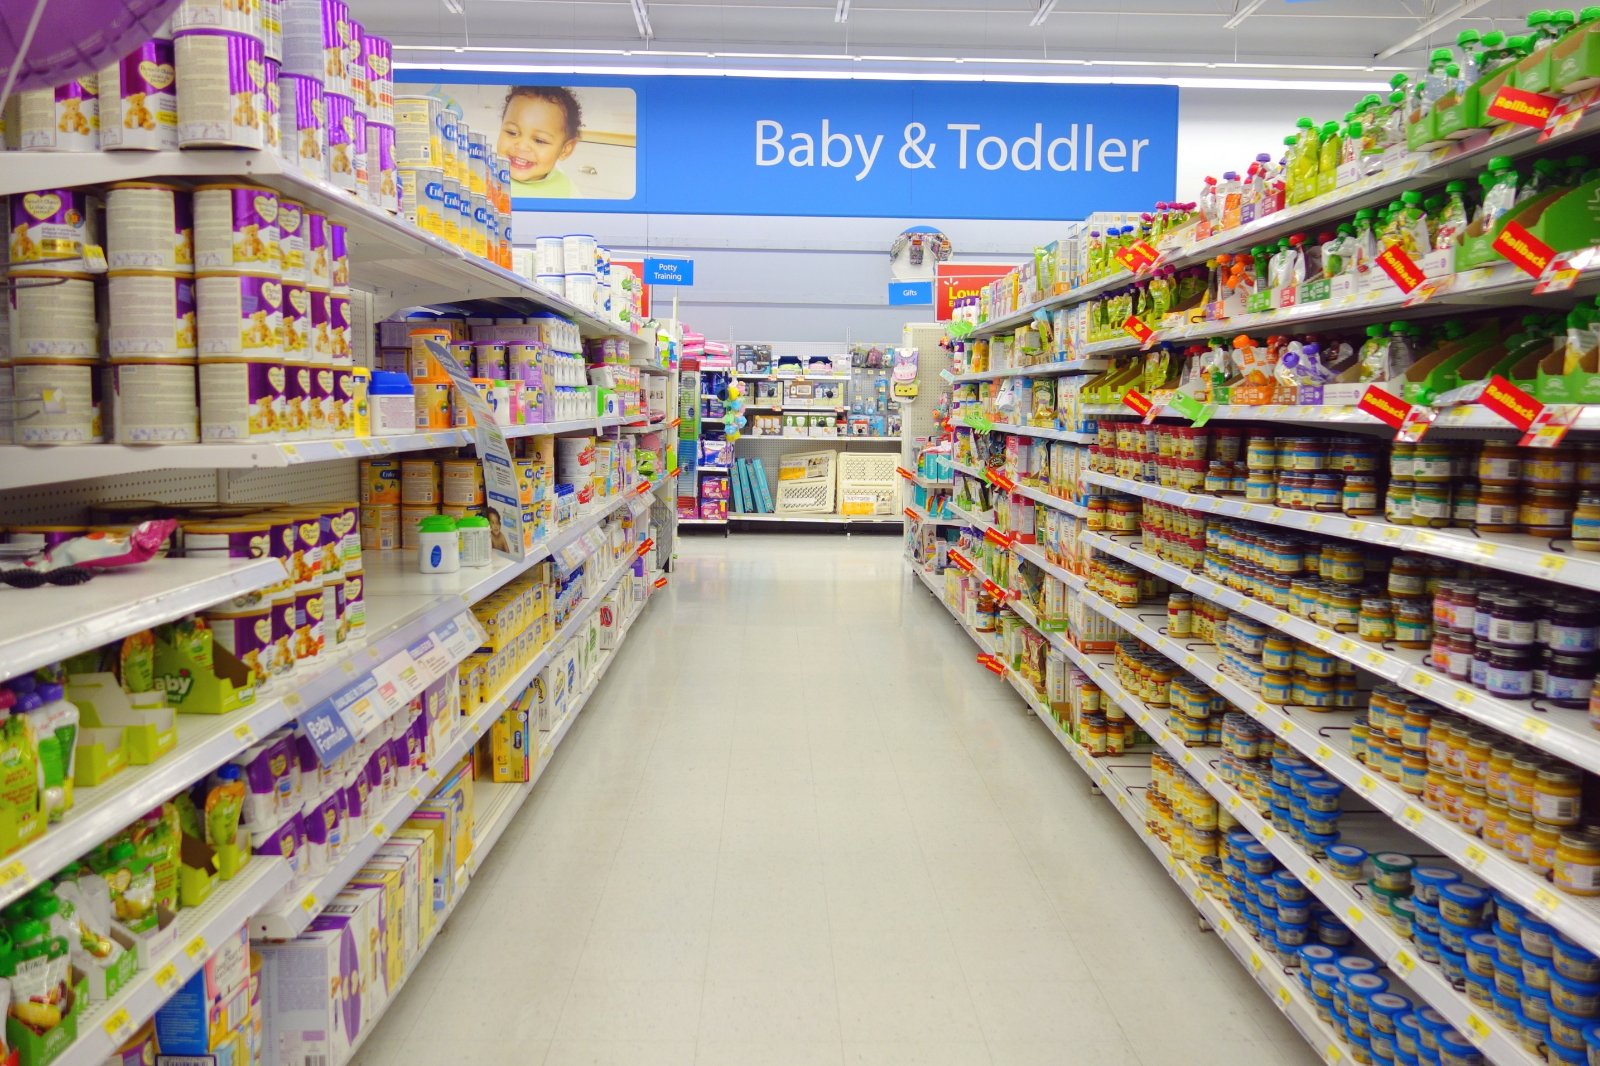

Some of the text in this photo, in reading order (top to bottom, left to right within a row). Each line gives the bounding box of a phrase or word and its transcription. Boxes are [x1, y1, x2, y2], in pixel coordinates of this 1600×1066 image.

[1494, 96, 1552, 119] Rollback
[755, 119, 1150, 182] Baby & Toddler
[1499, 230, 1547, 269] Rollback
[653, 272, 682, 281] Training
[658, 263, 678, 272] Potty
[1382, 250, 1417, 288] Rollback
[902, 289, 918, 297] Gifts
[1364, 393, 1406, 420] Rollback
[1485, 384, 1536, 422] Rollback
[155, 674, 191, 695] aby
[306, 715, 335, 739] Baby
[317, 726, 348, 754] Formula
